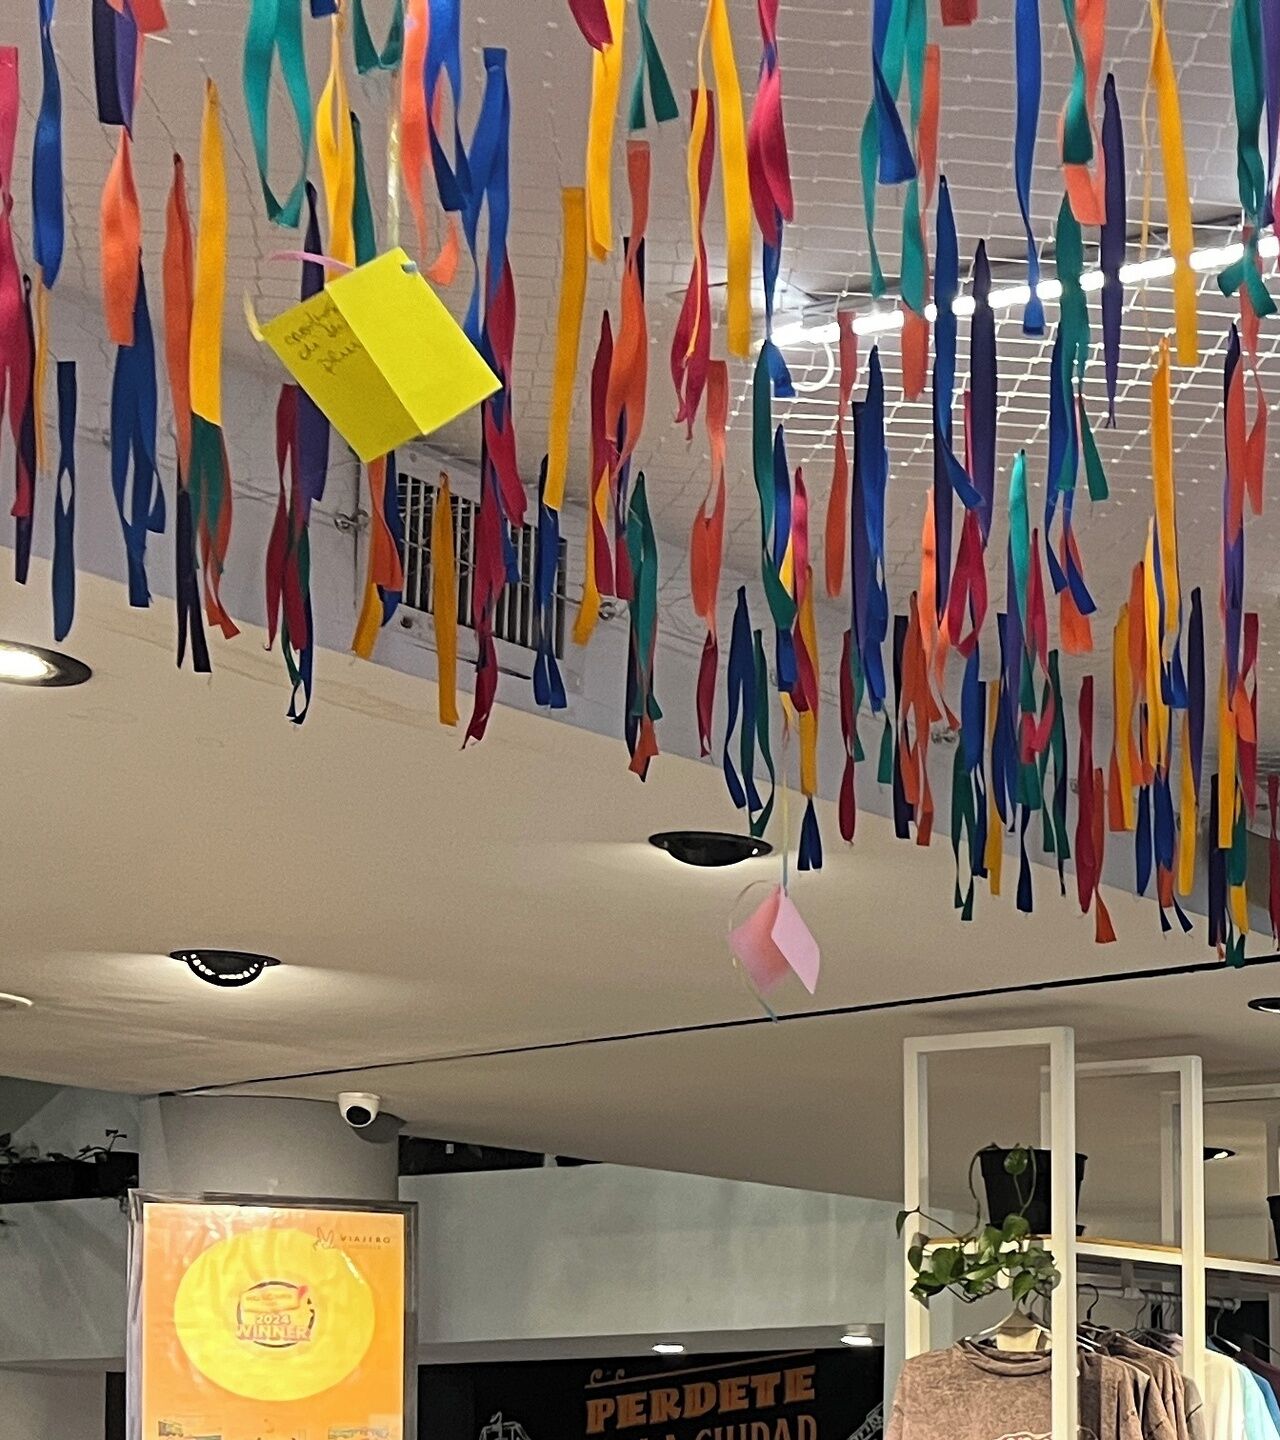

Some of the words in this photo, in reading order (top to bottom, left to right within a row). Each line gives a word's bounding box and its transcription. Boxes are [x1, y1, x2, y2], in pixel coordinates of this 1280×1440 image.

[255, 1313, 291, 1325] 2024
[236, 1323, 312, 1341] WINNER
[586, 1365, 816, 1435] PERDETE
